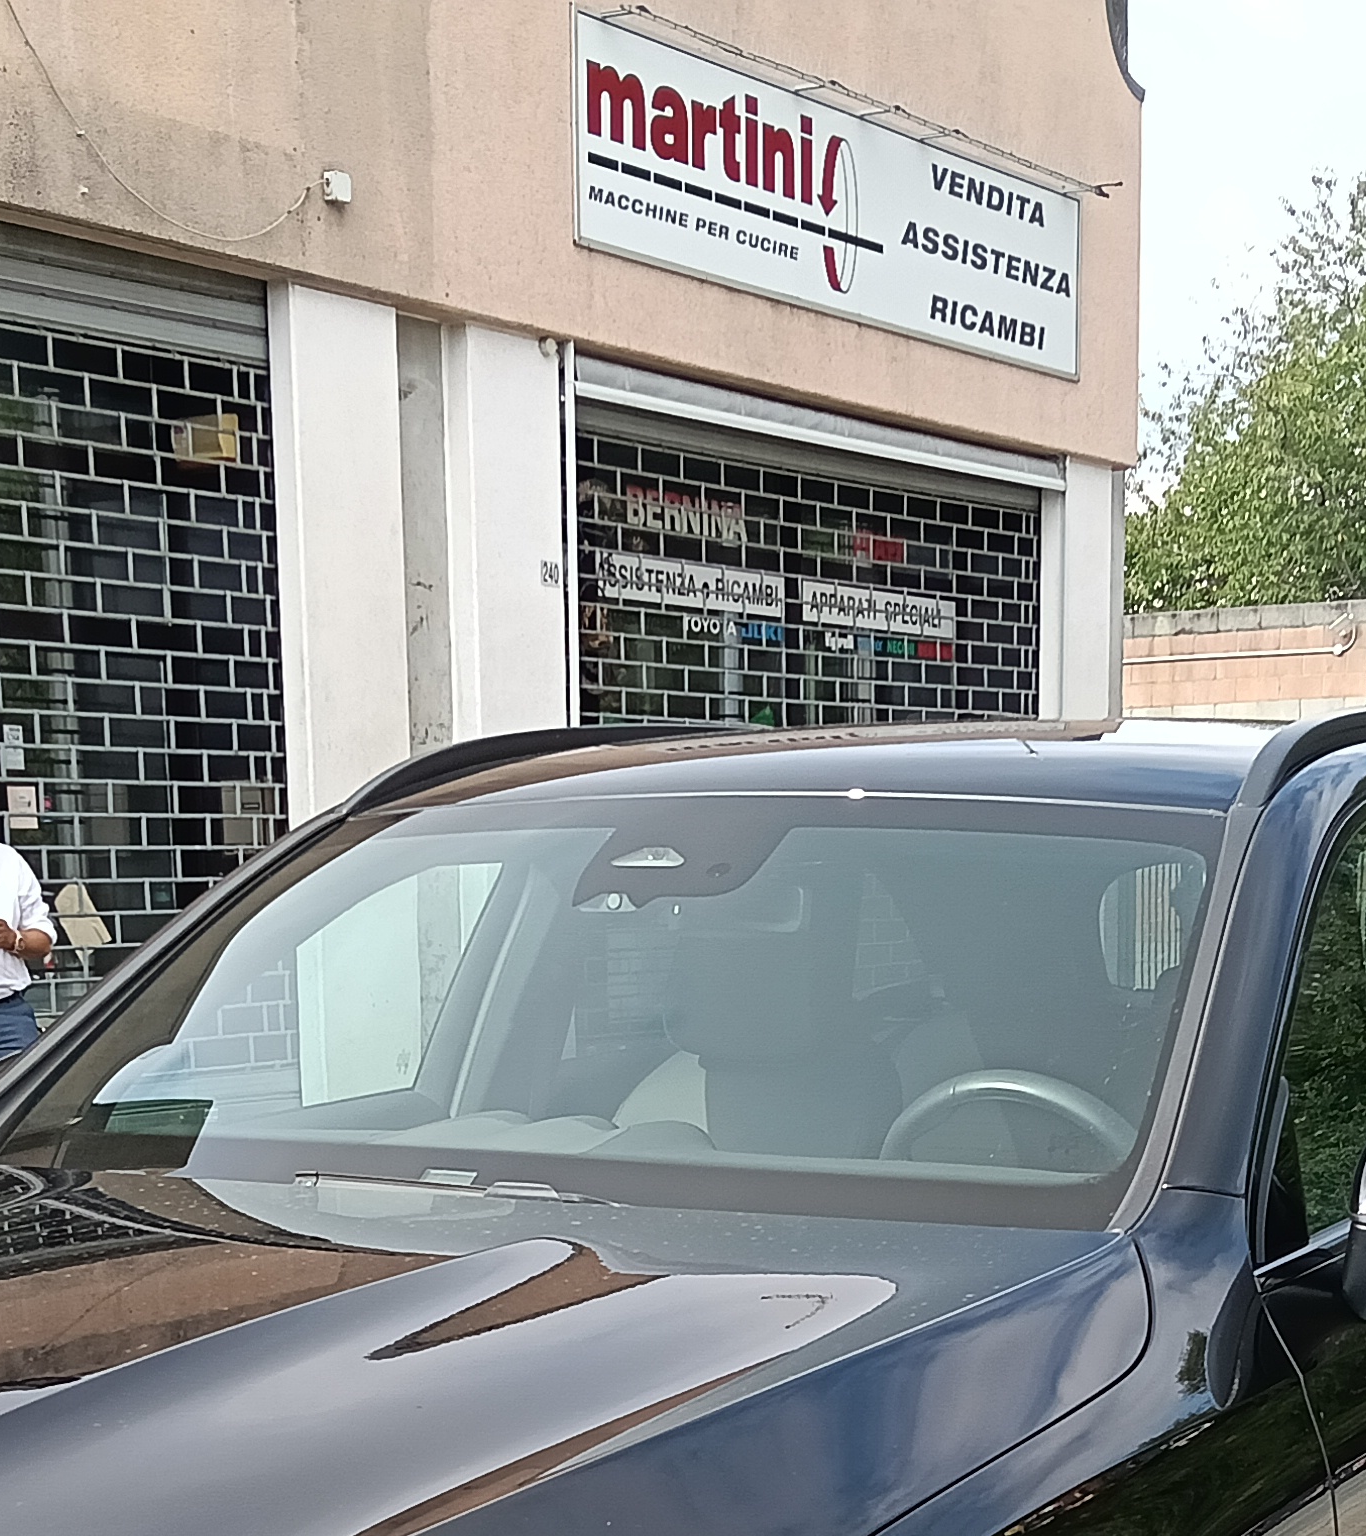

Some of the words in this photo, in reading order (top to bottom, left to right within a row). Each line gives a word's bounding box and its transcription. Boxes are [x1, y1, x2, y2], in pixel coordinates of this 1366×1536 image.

[586, 58, 814, 206] martini
[588, 184, 689, 229] MACCHINE
[695, 217, 730, 242] PER
[736, 229, 800, 262] CUCIRE
[931, 163, 1046, 229] VENDITA
[901, 221, 1072, 299] ASSISTENZA
[929, 294, 1046, 351] RICAMBI
[543, 560, 560, 585] 240
[598, 561, 698, 598] ASSISTENZA
[715, 577, 779, 608] RICAMBI
[685, 616, 737, 636] TOYOA
[809, 590, 877, 621] APPARATI
[885, 600, 942, 630] SPECIALI
